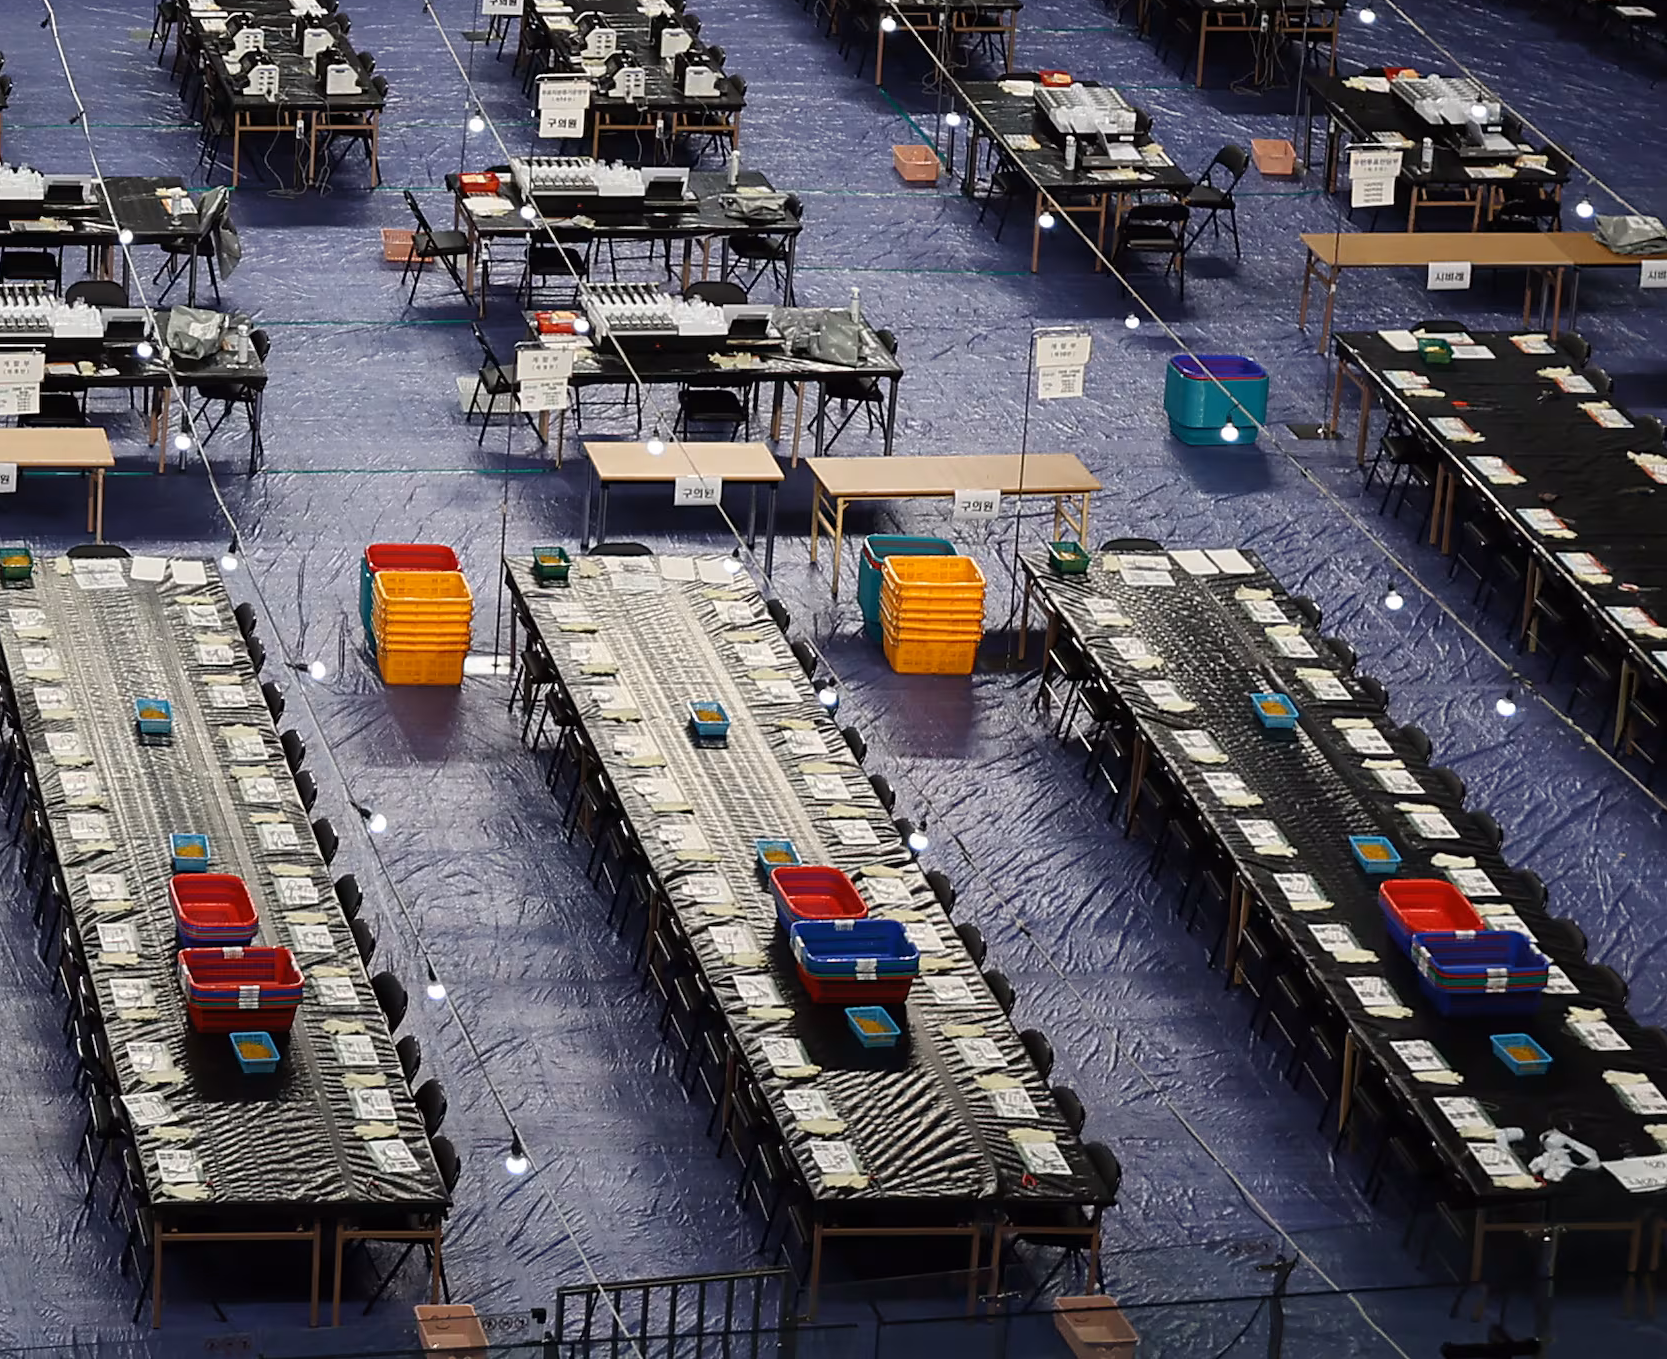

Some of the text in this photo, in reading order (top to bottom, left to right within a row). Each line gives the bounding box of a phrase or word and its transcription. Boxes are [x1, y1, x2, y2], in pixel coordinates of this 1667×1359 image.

[547, 118, 577, 129] 구의원
[682, 487, 715, 499] 구의원
[962, 500, 993, 513] 구의원
